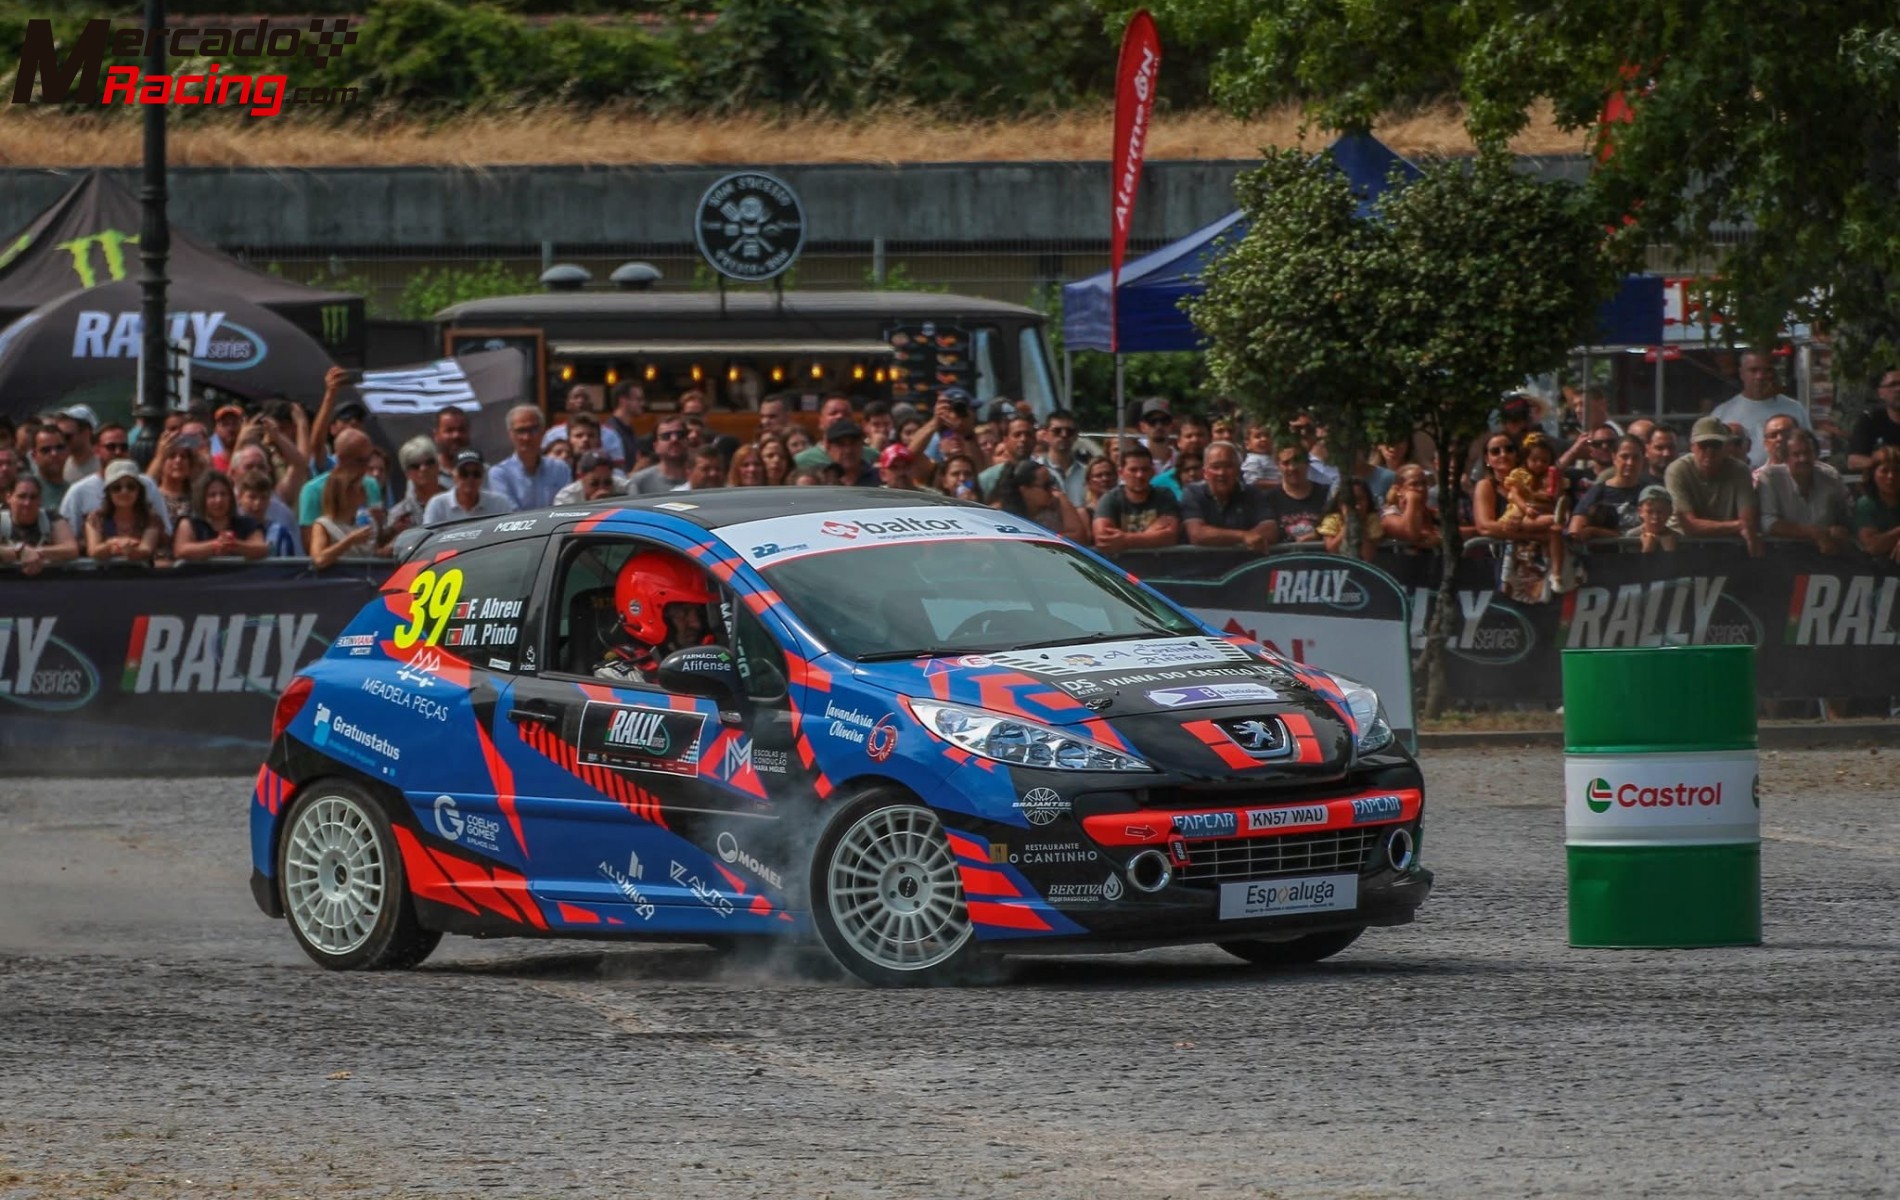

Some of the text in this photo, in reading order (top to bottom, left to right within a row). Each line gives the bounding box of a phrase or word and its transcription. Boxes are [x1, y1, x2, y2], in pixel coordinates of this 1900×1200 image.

[207, 340, 251, 359] series
[853, 517, 964, 534] baltor
[1273, 569, 1350, 604] RALLY
[393, 568, 464, 650] 39
[466, 597, 523, 619] F. Abreu
[1566, 575, 1728, 648] RALLY
[460, 624, 518, 646] M. Pinto
[134, 614, 319, 693] RALLY
[681, 660, 732, 673] Afifense
[1060, 678, 1097, 692] DS
[1102, 673, 1162, 687] VIANA
[1158, 671, 1187, 680] DO
[1186, 667, 1256, 678] CASTELO
[361, 676, 450, 722] MEADELA PEÇAS
[824, 699, 875, 729] Lavandaria
[609, 709, 666, 747] RALLY
[829, 720, 865, 744] Oliveira
[1616, 781, 1724, 808] Castrol
[466, 814, 500, 833] COELHO
[1173, 812, 1236, 830] FAPCAR
[1252, 810, 1288, 826] KN57
[1292, 807, 1324, 823] WAU
[466, 825, 496, 842] GOMES
[1008, 850, 1099, 864] O CANTINHO
[1025, 842, 1080, 851] RESTAURANTE
[738, 849, 784, 890] MOMEL
